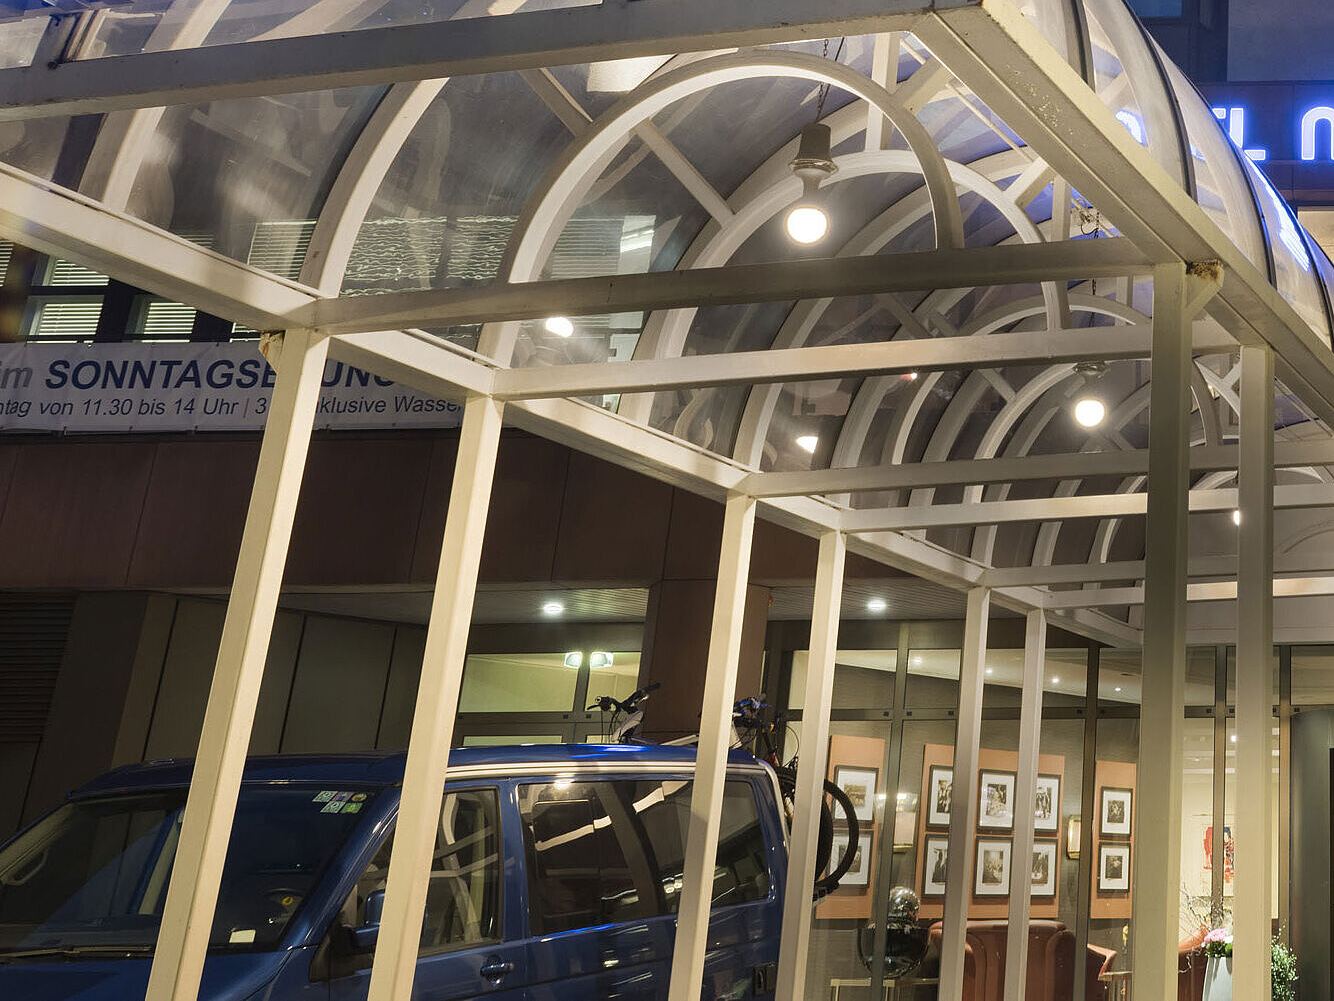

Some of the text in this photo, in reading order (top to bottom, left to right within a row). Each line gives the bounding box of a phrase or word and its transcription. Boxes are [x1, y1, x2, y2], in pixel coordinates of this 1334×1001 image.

[40, 402, 73, 415] von
[83, 399, 132, 415] 11.30
[138, 399, 166, 415] bis
[174, 399, 195, 415] 14
[203, 399, 239, 415] Uhr
[317, 397, 386, 414] klusive
